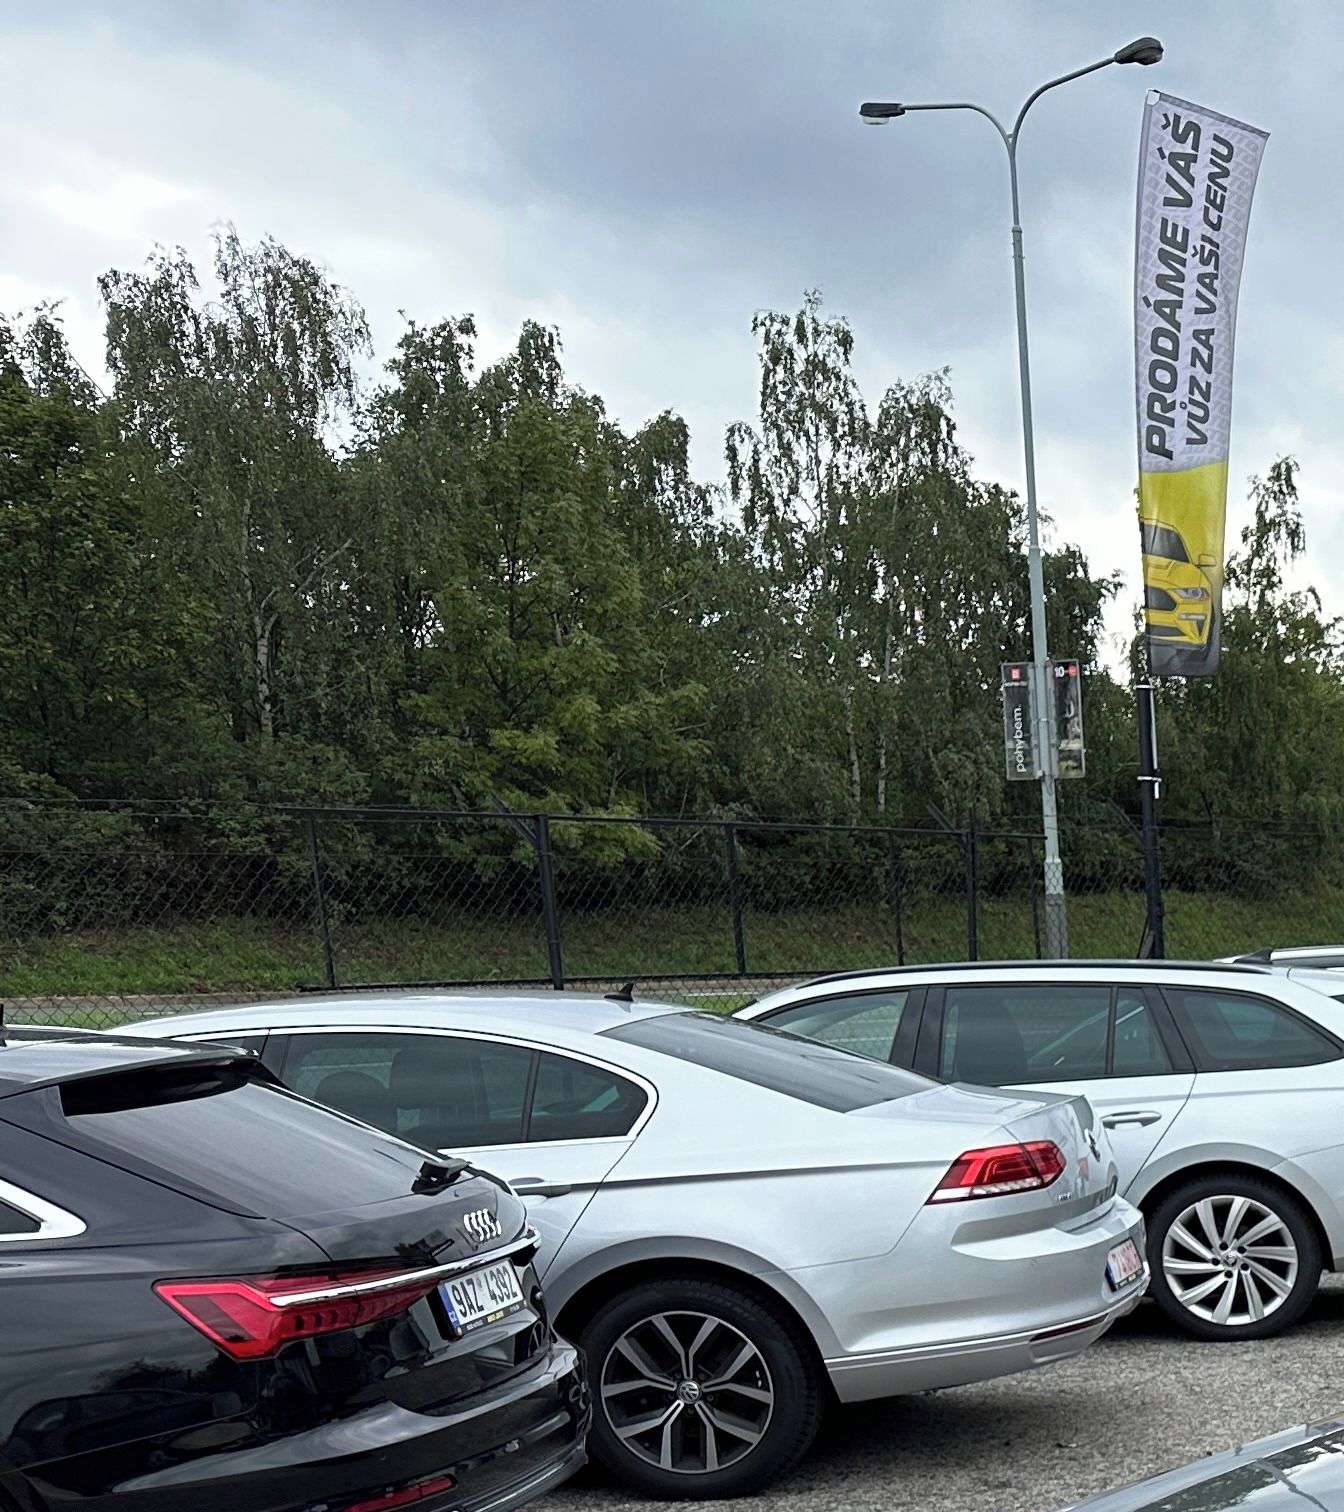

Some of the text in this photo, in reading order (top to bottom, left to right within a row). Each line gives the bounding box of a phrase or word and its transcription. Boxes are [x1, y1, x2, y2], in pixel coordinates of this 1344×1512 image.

[1142, 113, 1202, 461] PRODÁME VÁŠ
[1180, 133, 1234, 445] VŮZ ZA VAŠI CENU
[451, 1265, 518, 1318] 9AZ 4392
